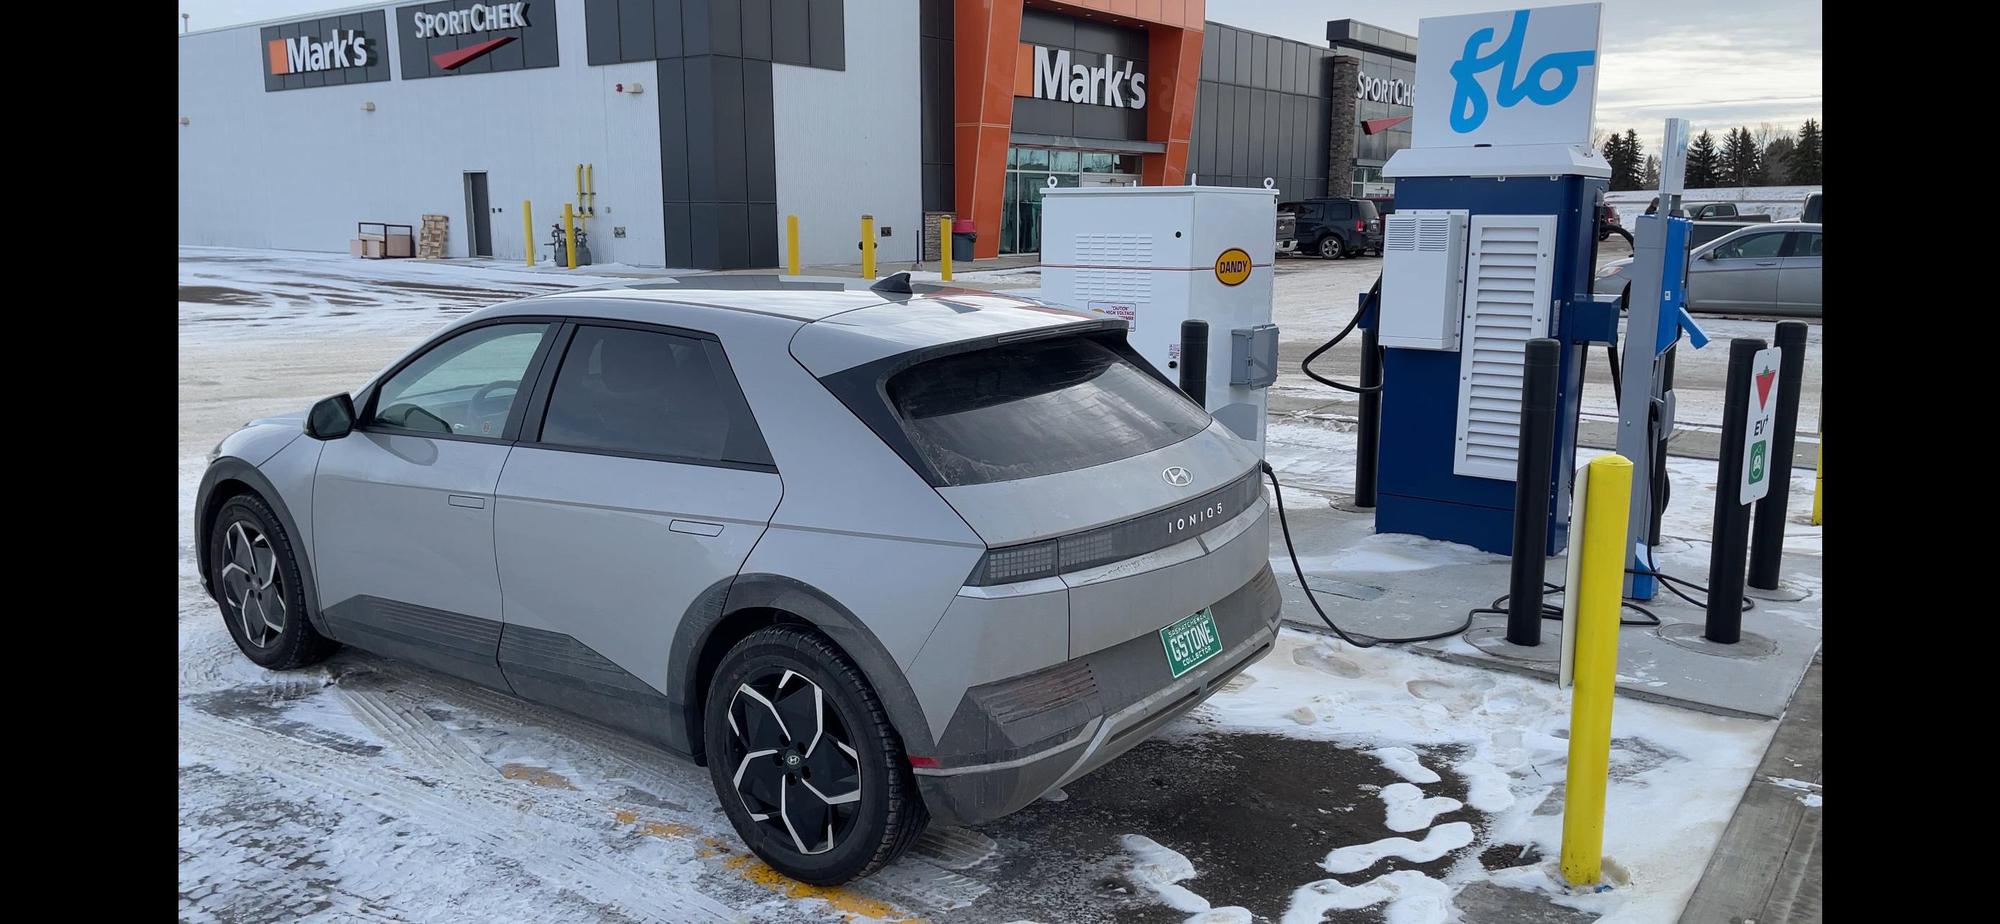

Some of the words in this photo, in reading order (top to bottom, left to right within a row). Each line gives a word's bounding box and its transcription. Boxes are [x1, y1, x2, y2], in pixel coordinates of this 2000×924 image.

[286, 29, 368, 74] Mark's
[1449, 9, 1595, 133] flo
[1033, 45, 1146, 110] Mark's
[1220, 260, 1248, 274] DANDY
[1170, 620, 1215, 662] GSTONE
[1182, 645, 1212, 667] COLLECTOR
